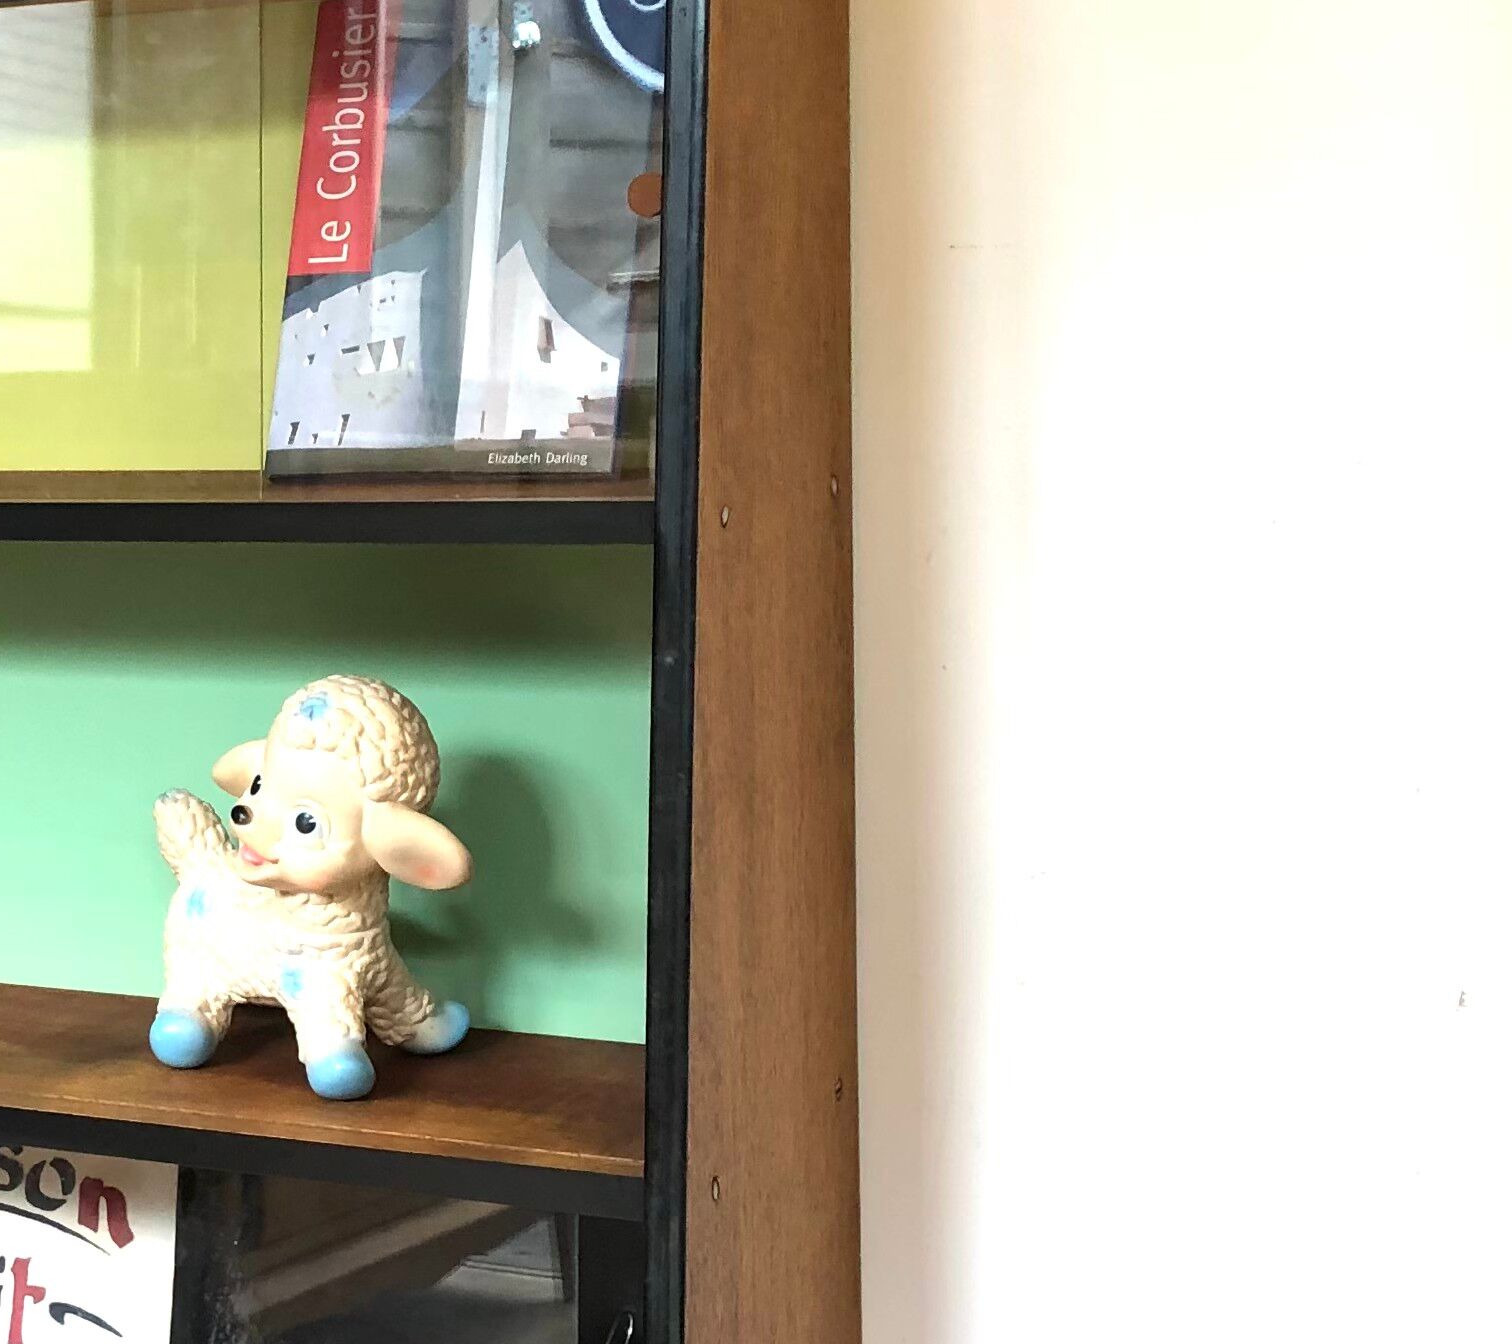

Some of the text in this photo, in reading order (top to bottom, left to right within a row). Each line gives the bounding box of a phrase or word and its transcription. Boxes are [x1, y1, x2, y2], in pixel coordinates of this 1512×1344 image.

[308, 10, 377, 264] Le Corbusier
[487, 451, 588, 466] Elizabeth Darling
